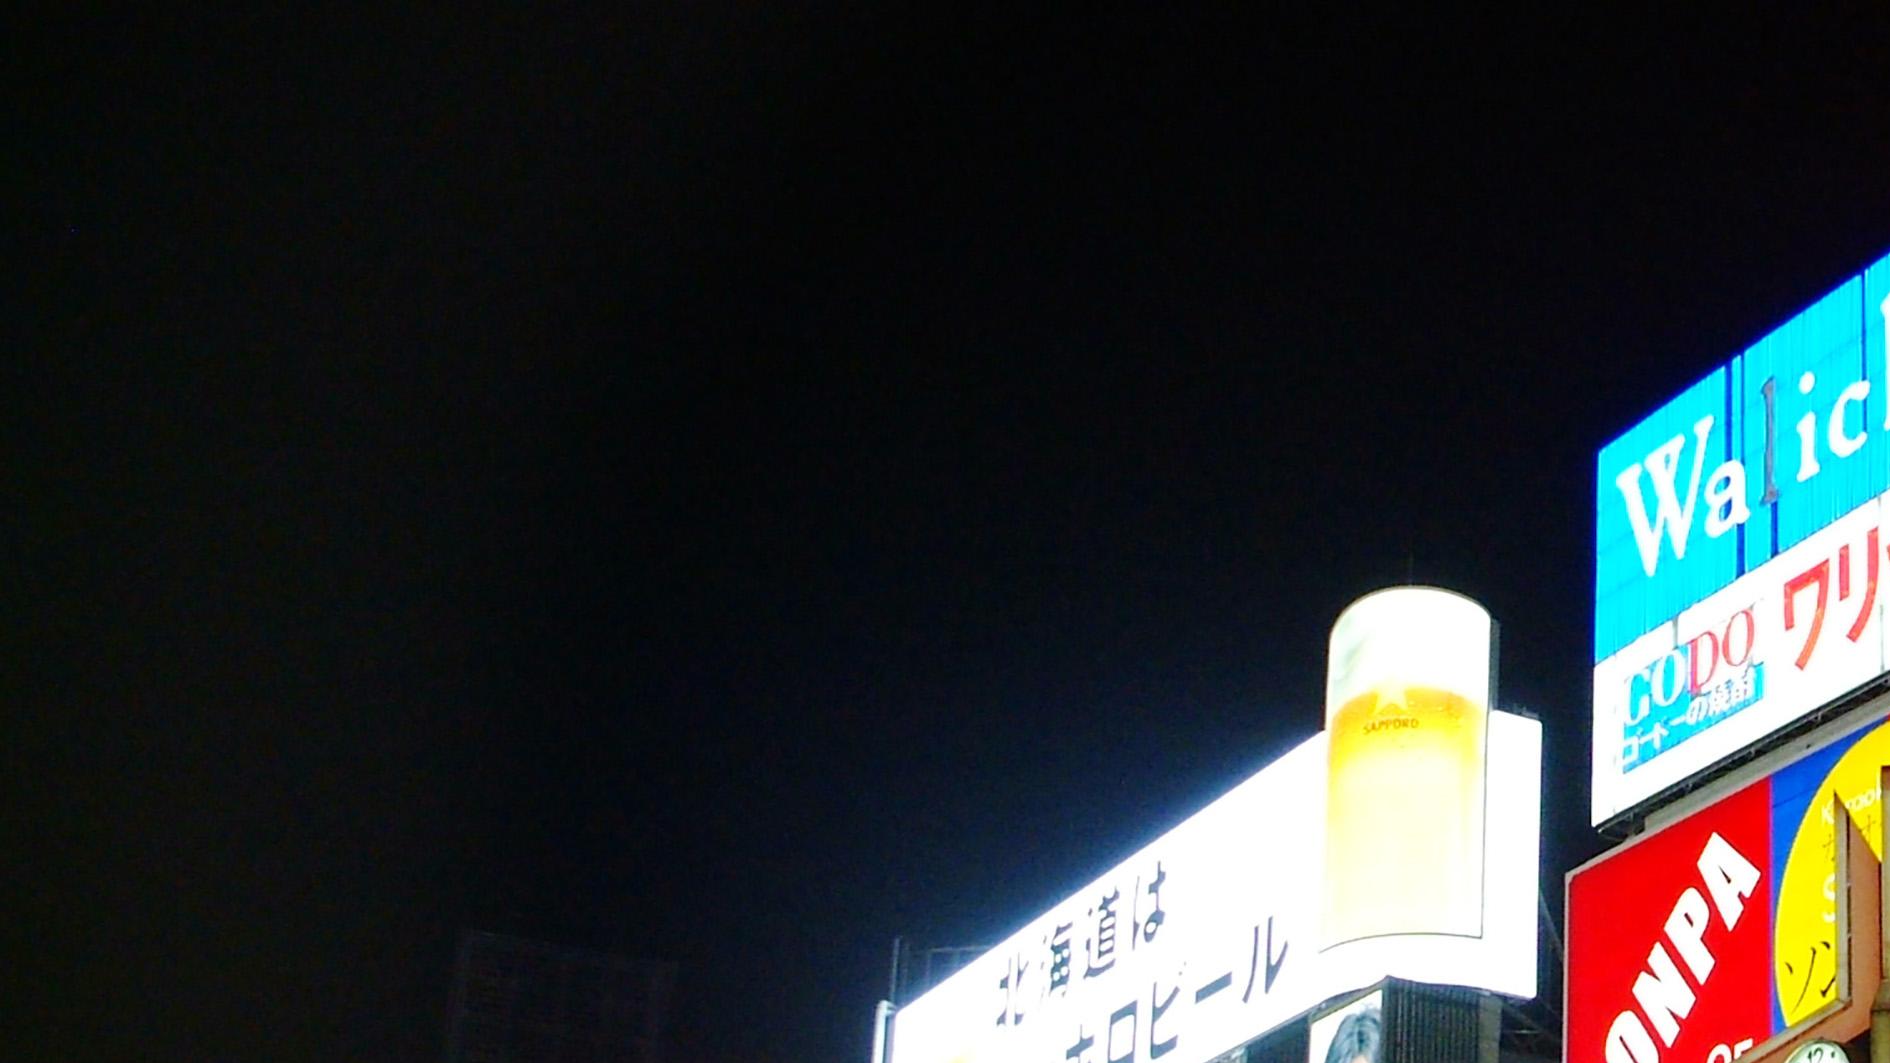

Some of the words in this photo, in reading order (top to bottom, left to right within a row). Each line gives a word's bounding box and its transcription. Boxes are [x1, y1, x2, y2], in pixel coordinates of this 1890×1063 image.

[1363, 717, 1419, 735] SAPPORO
[996, 860, 1166, 1027] 北海道は
